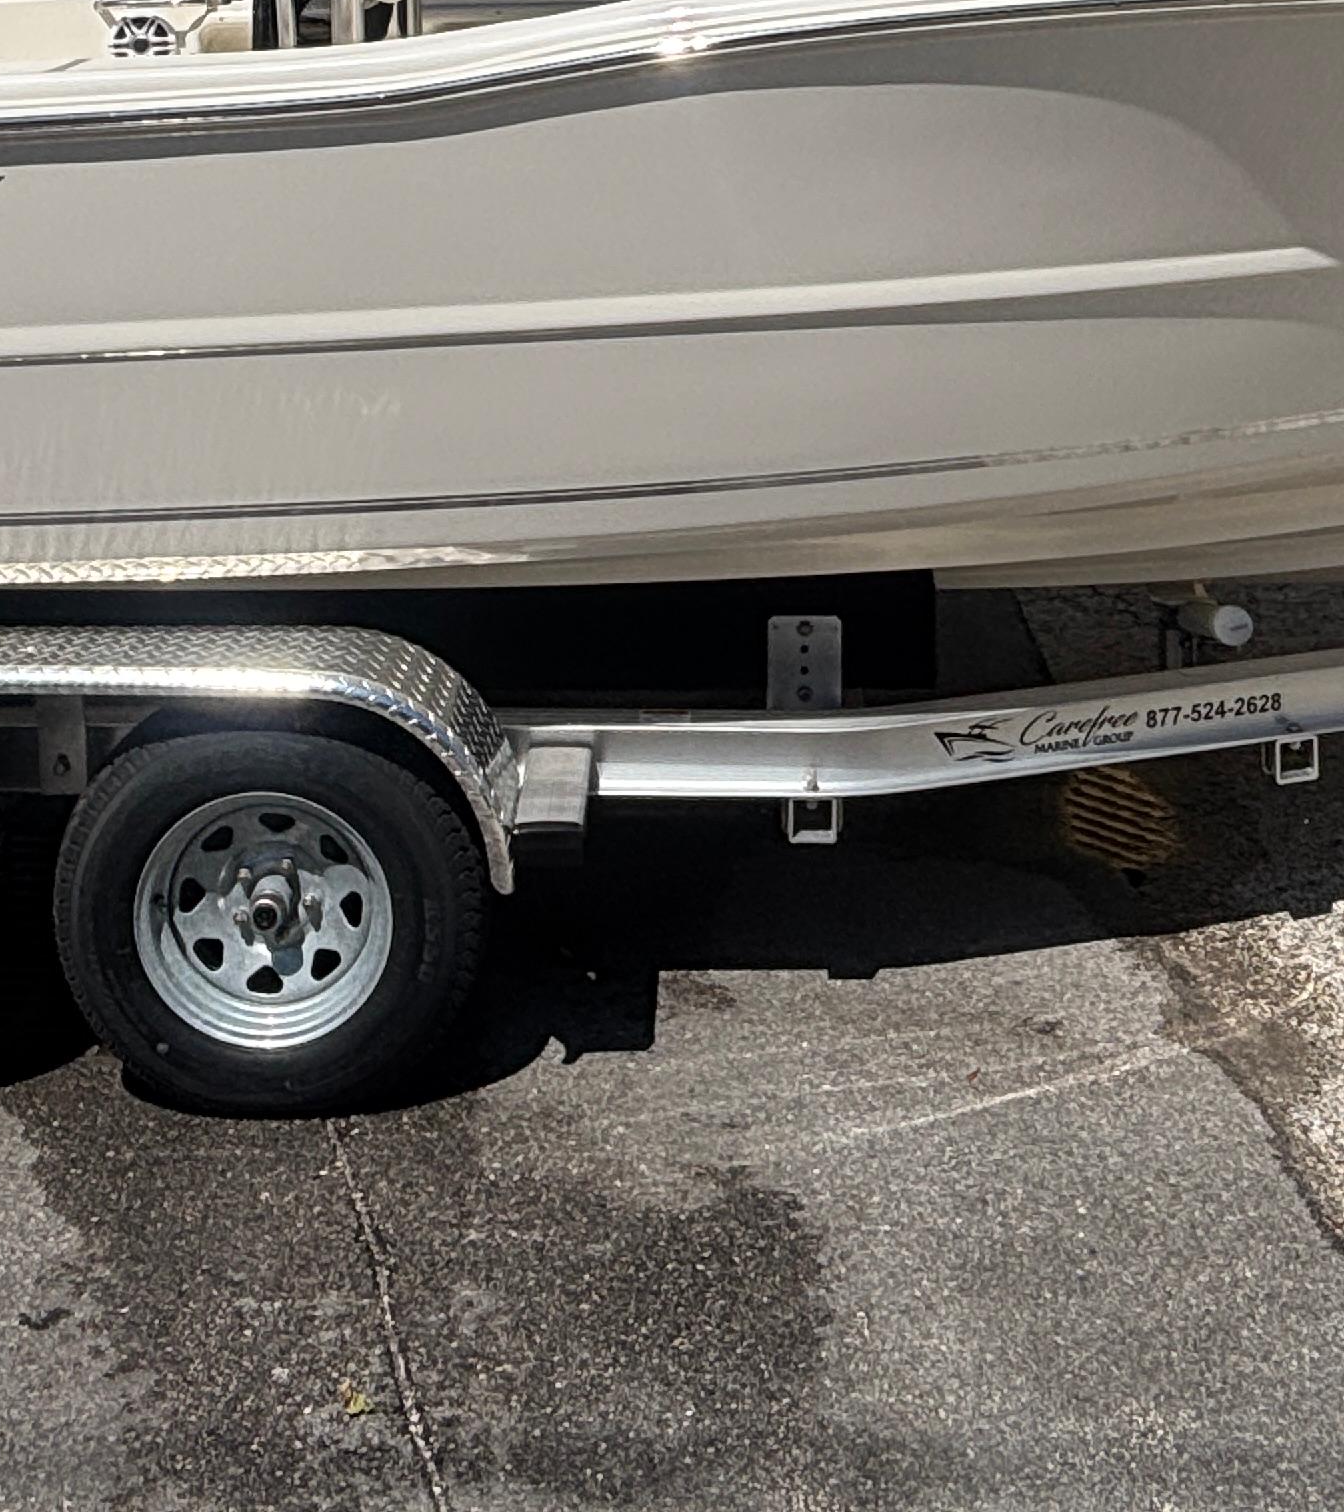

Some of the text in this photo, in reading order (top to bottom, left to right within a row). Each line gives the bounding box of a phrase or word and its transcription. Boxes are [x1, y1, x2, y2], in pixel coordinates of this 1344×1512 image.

[1019, 692, 1283, 748] Carefree 877-524-2628
[1034, 730, 1134, 754] MARINE GROUP
